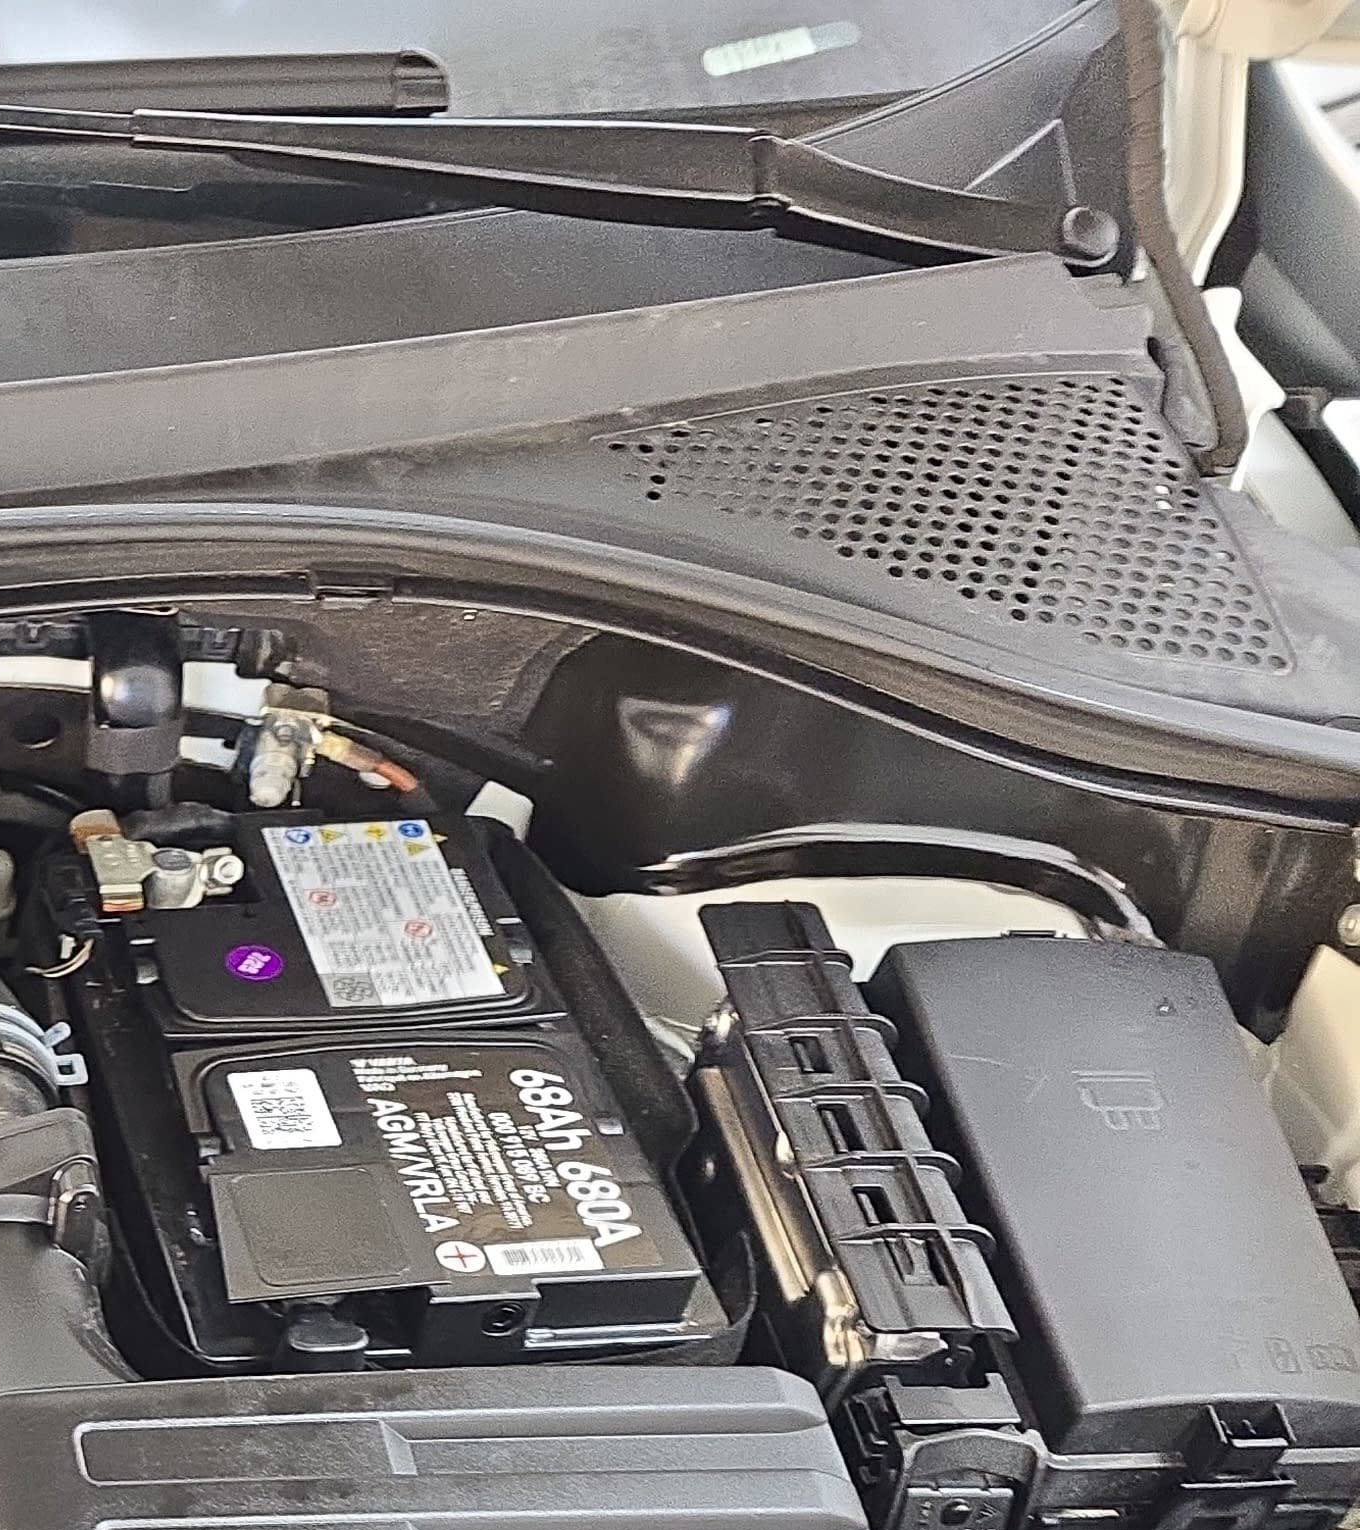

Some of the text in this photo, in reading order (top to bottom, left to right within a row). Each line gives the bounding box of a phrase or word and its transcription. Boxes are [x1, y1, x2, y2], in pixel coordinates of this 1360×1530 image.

[366, 1097, 461, 1233] AGM/VRLA
[486, 1112, 518, 1133] 000
[508, 1068, 643, 1248] 68Ah 680A
